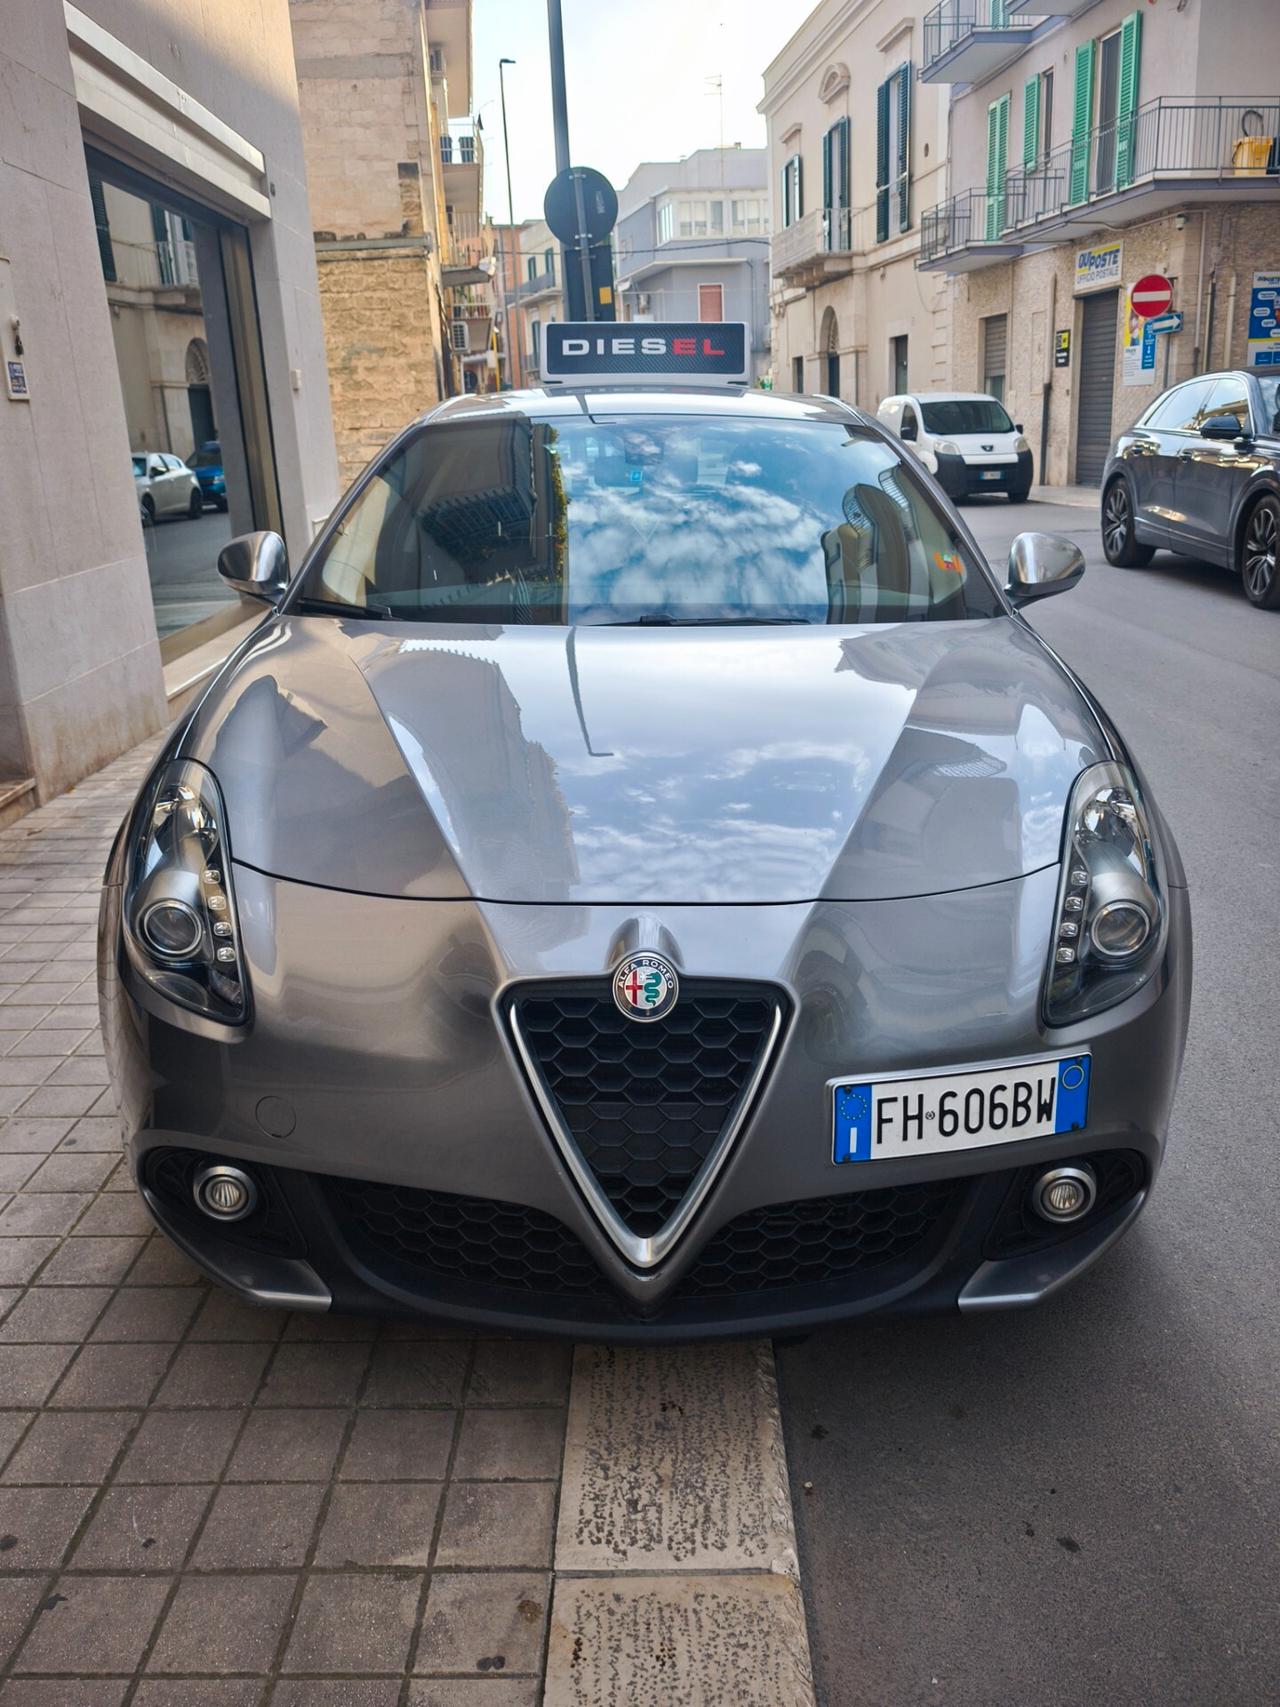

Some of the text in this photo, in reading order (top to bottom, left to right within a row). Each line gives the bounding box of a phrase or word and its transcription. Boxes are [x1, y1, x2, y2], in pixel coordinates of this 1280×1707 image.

[562, 337, 725, 356] DIESEL
[618, 959, 674, 989] ALFA ROMEO
